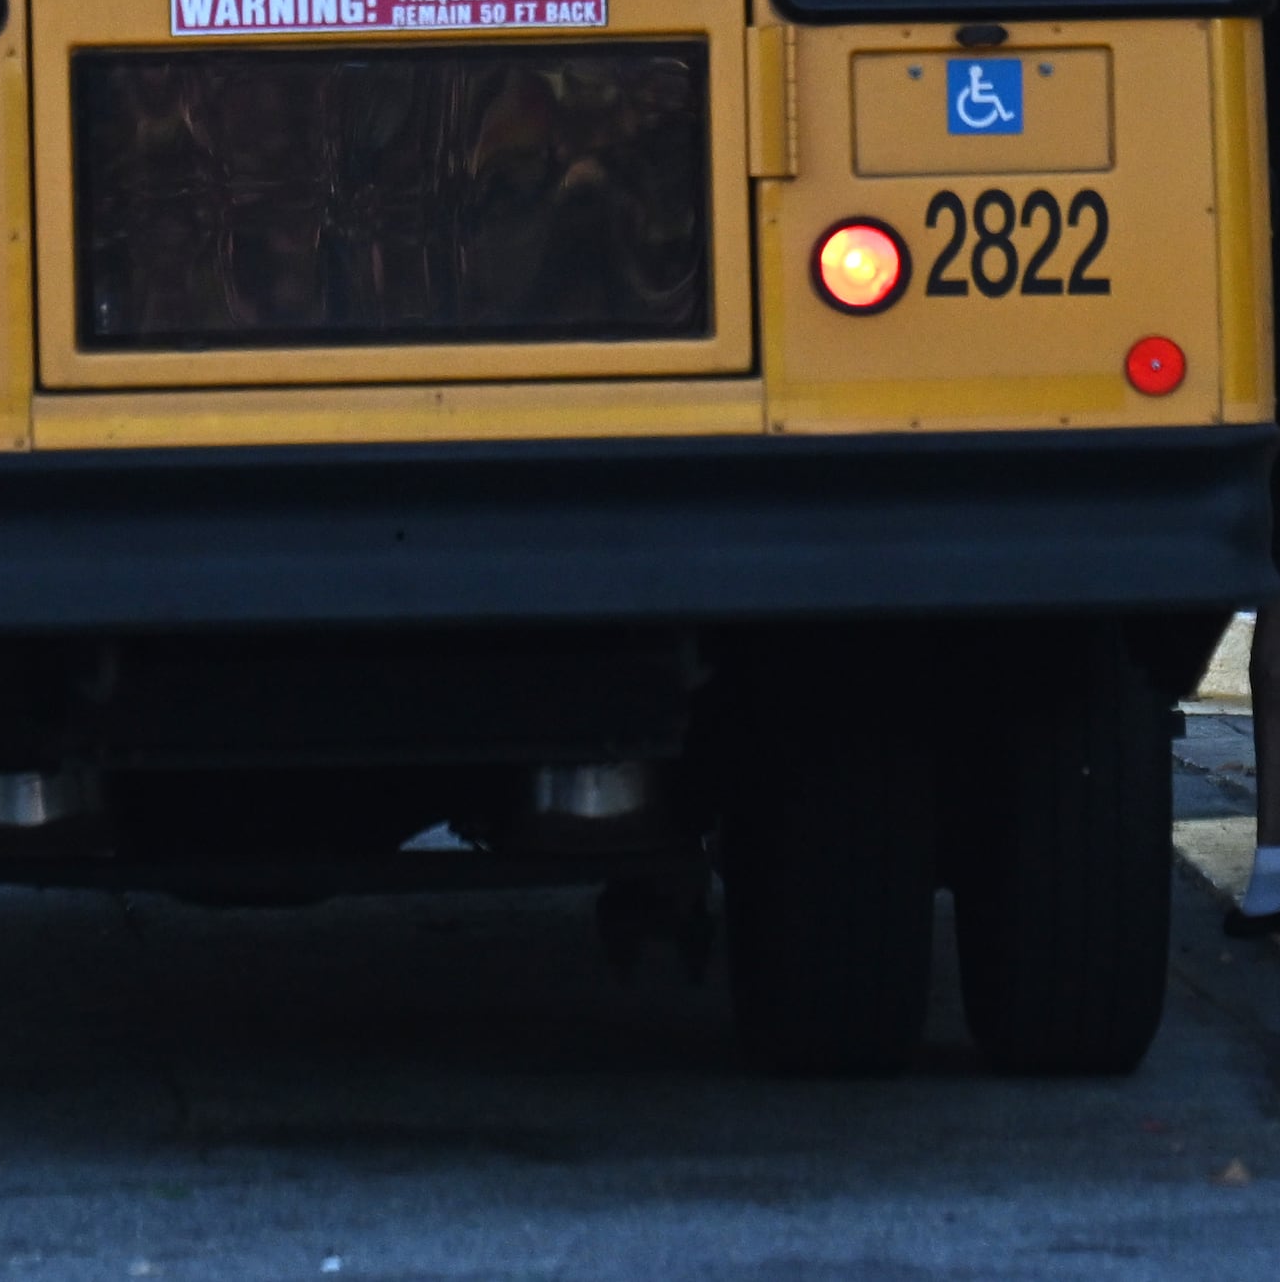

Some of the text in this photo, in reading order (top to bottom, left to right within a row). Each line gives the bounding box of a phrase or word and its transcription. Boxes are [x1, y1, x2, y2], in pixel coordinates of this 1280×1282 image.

[392, 0, 596, 27] REMAIN 50 FT BACK
[924, 188, 1112, 299] 2822
